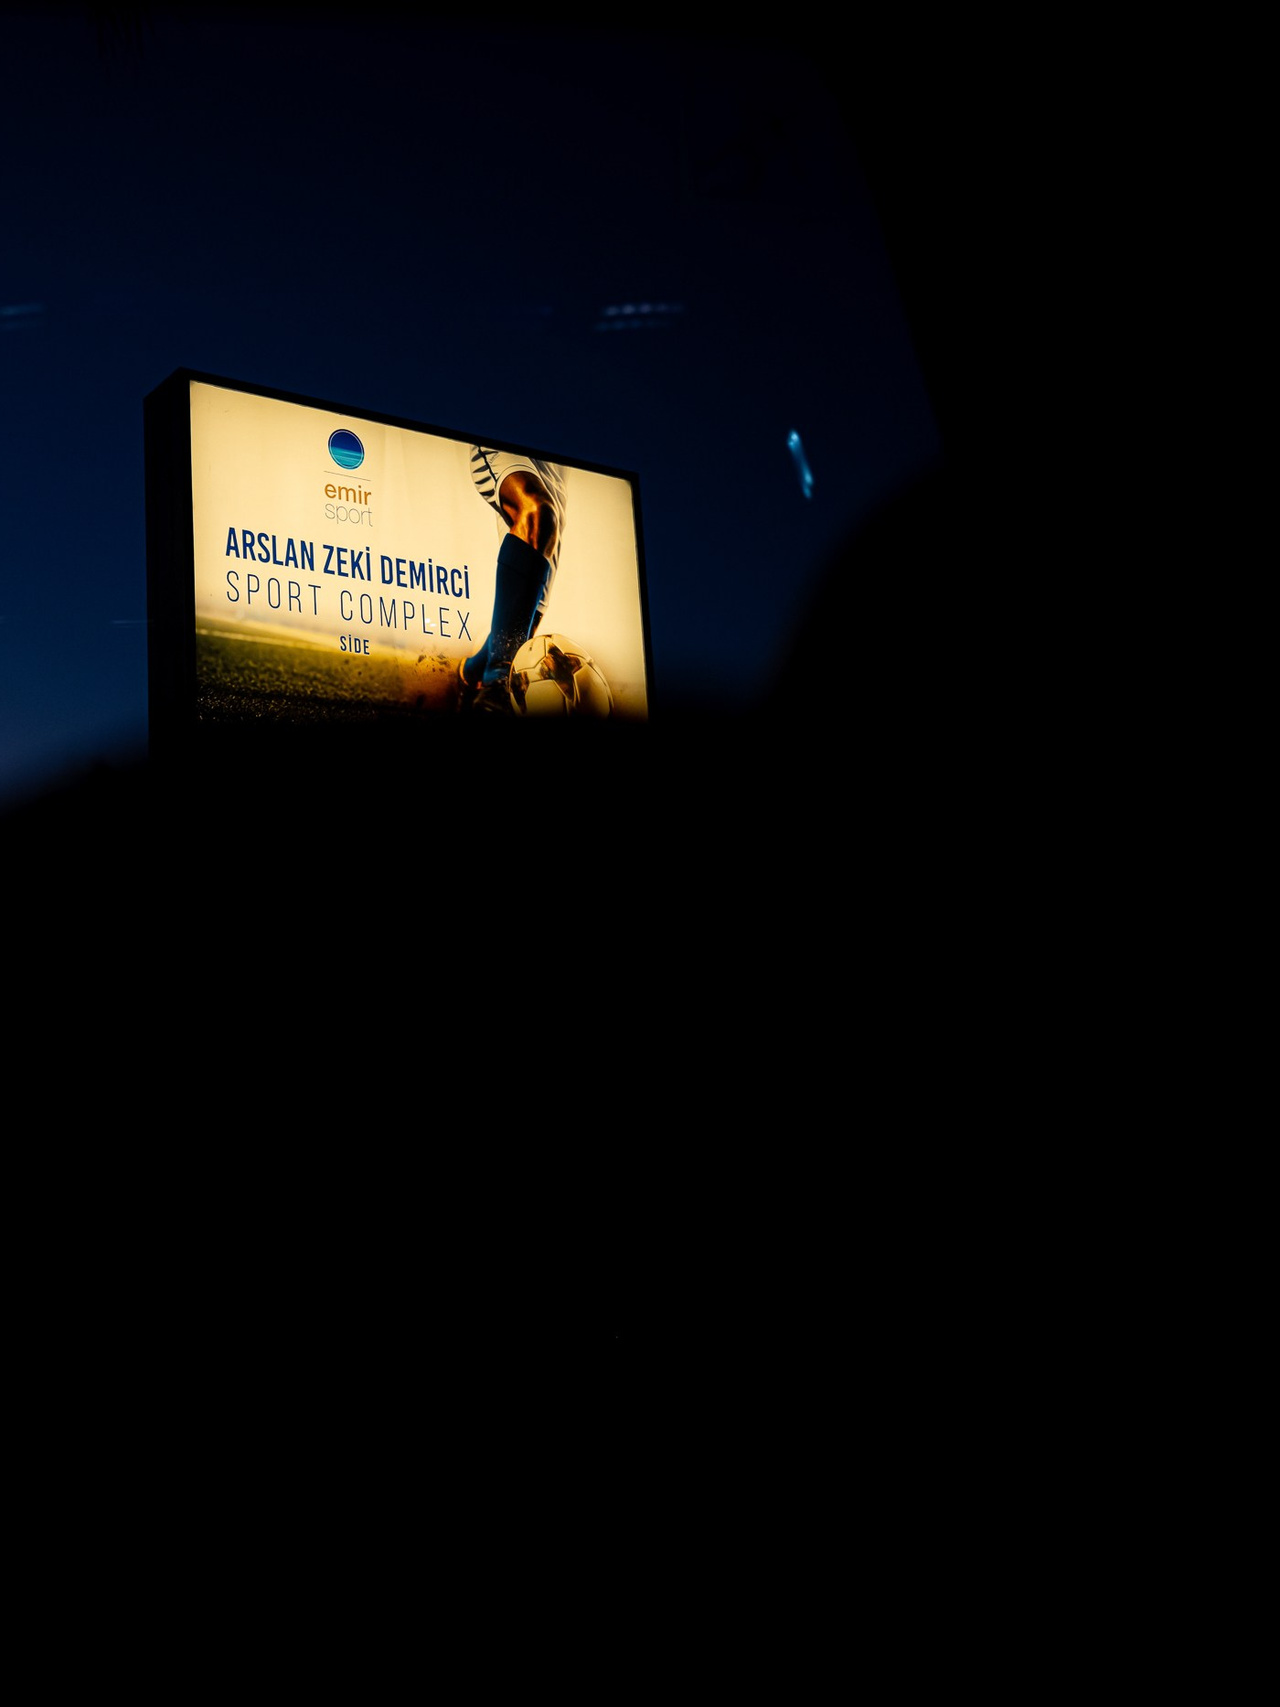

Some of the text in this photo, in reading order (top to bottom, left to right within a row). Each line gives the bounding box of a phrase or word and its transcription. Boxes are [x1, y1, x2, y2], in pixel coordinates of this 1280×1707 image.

[324, 483, 372, 506] emir
[324, 503, 373, 528] sport
[225, 526, 470, 600] ARSLAN ZEKİ DEMİRCİ
[226, 570, 472, 642] SPORT COMPLEX
[339, 634, 370, 656] SİDE
